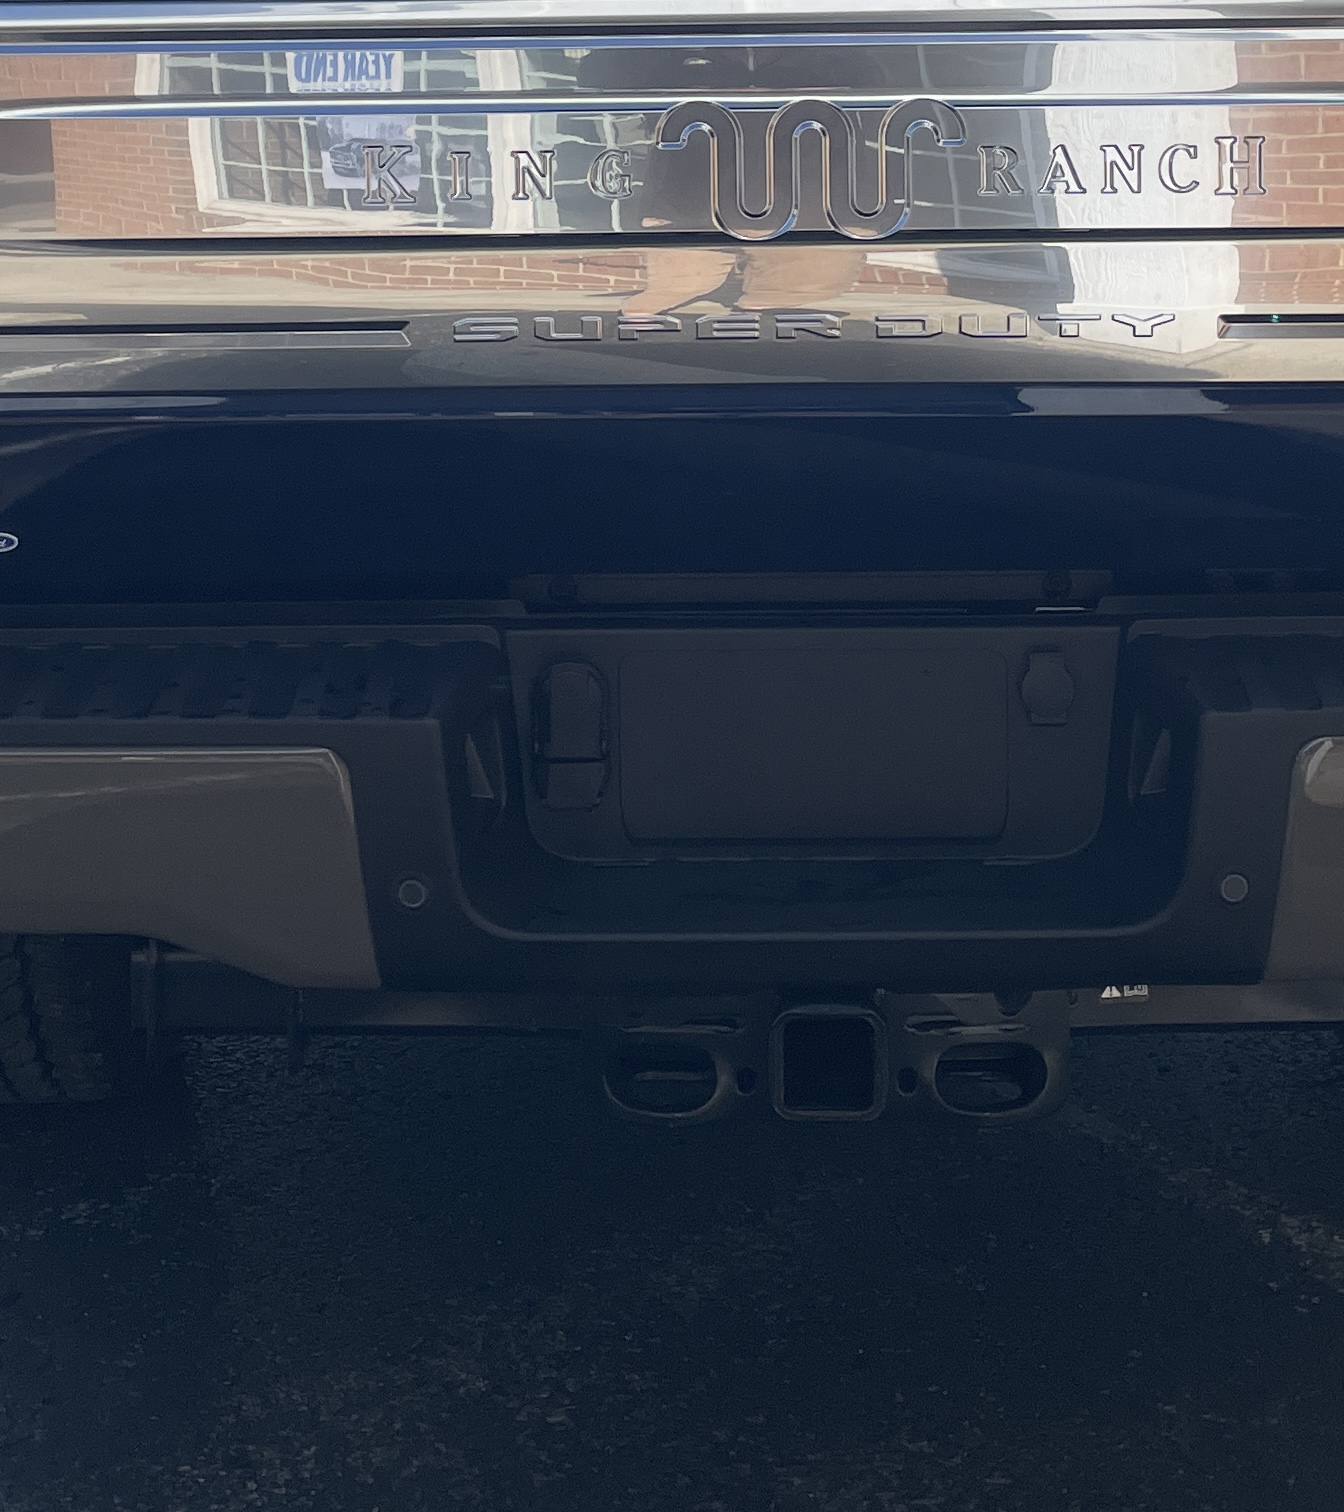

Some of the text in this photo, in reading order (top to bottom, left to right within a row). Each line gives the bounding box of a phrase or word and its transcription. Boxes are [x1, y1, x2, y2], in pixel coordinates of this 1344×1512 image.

[361, 144, 635, 206] KING
[976, 135, 1268, 197] RANCH
[453, 313, 1176, 344] SUPER DUTY
